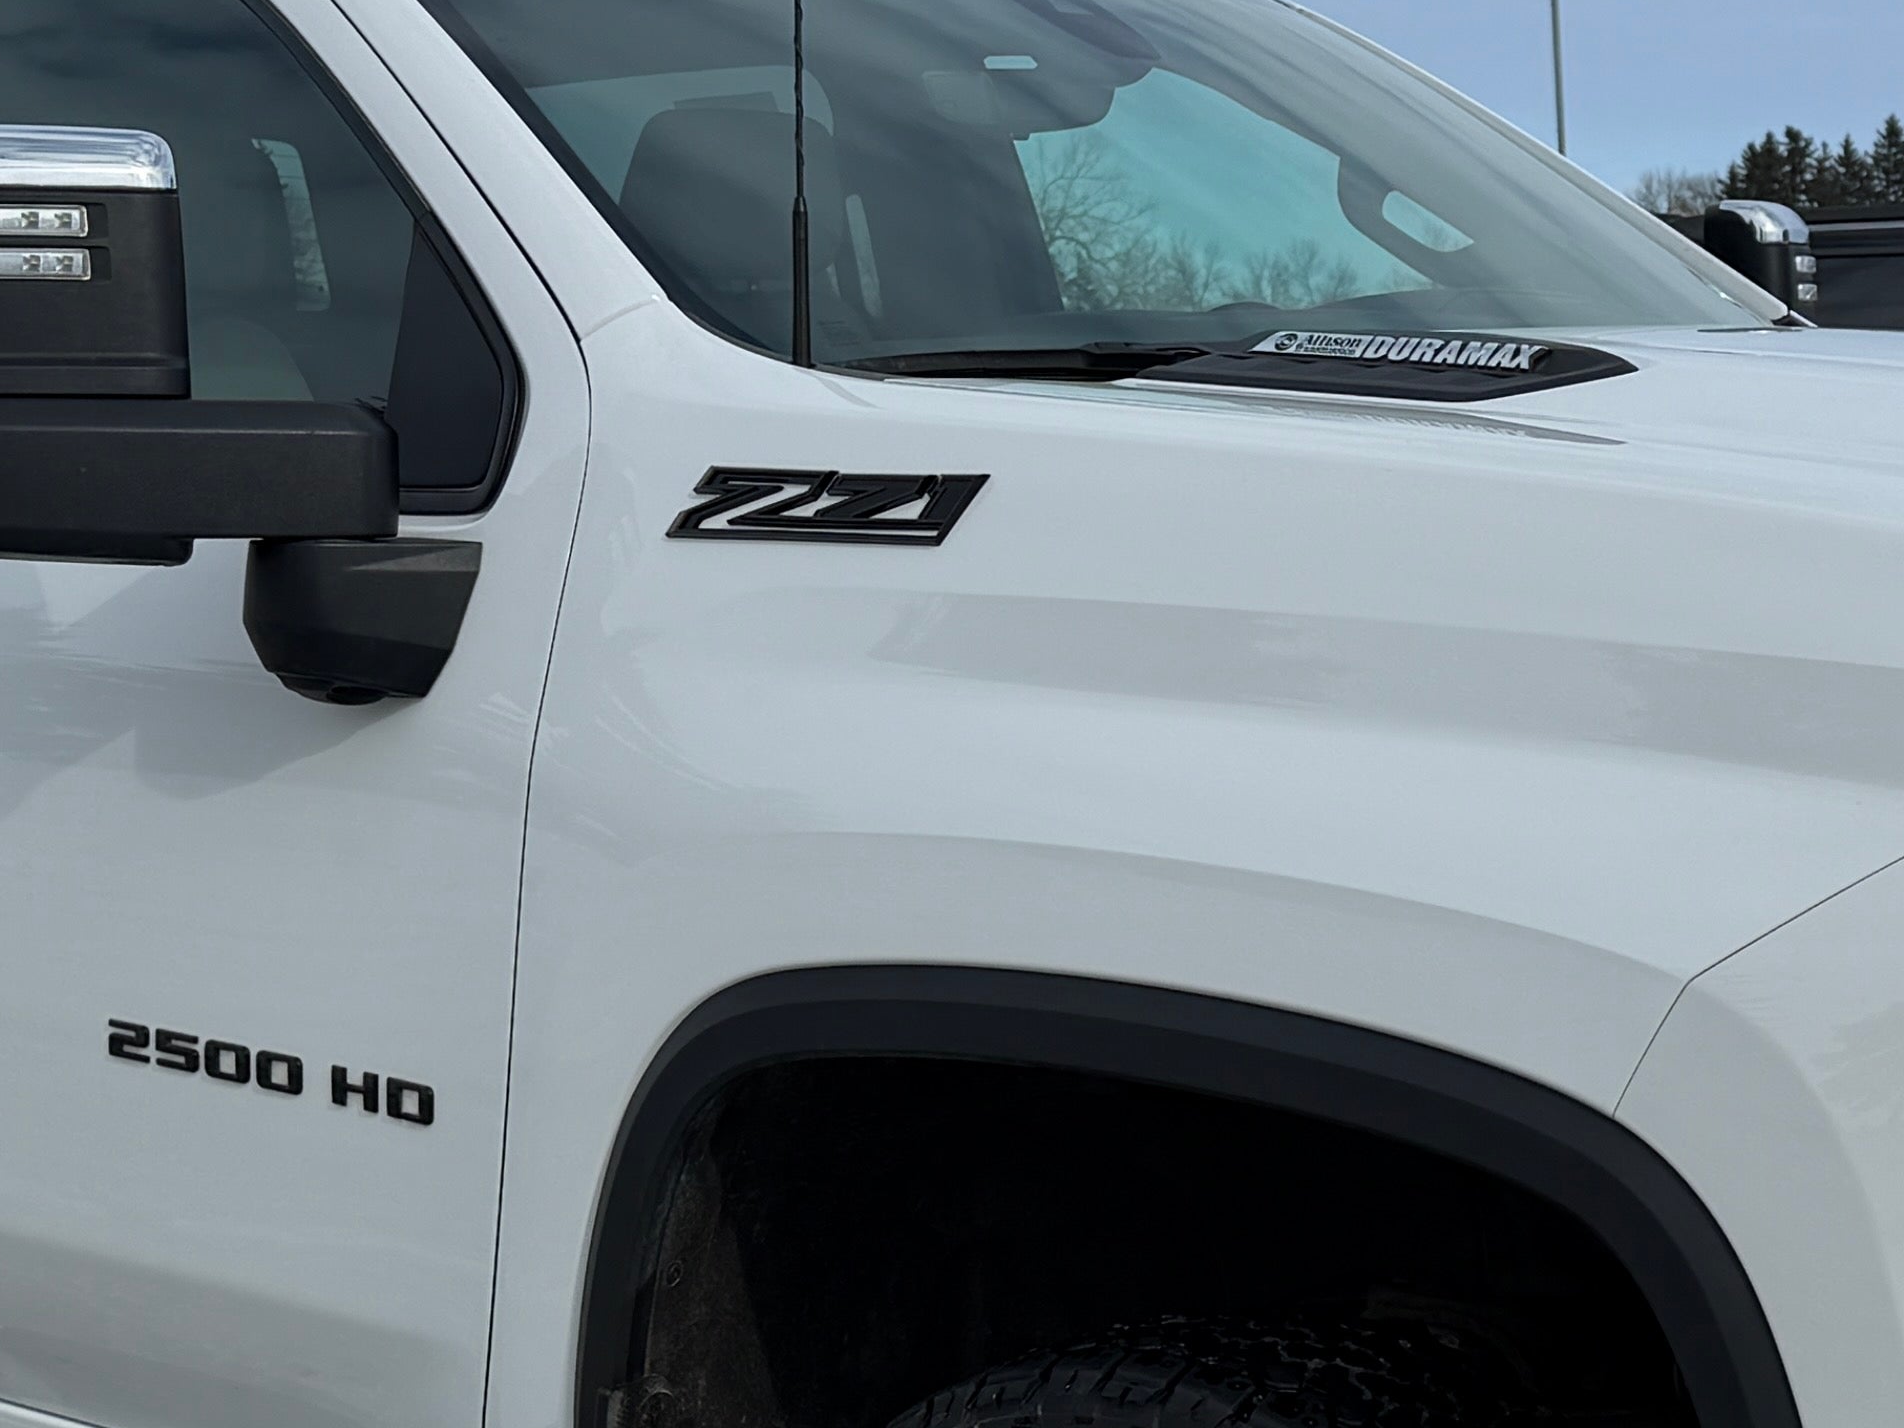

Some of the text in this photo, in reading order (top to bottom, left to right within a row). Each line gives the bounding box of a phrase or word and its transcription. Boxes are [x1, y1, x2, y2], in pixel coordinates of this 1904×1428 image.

[1305, 334, 1362, 348] Allison
[1361, 335, 1548, 371] DURAMAX
[108, 1018, 435, 1127] 2500 HD
